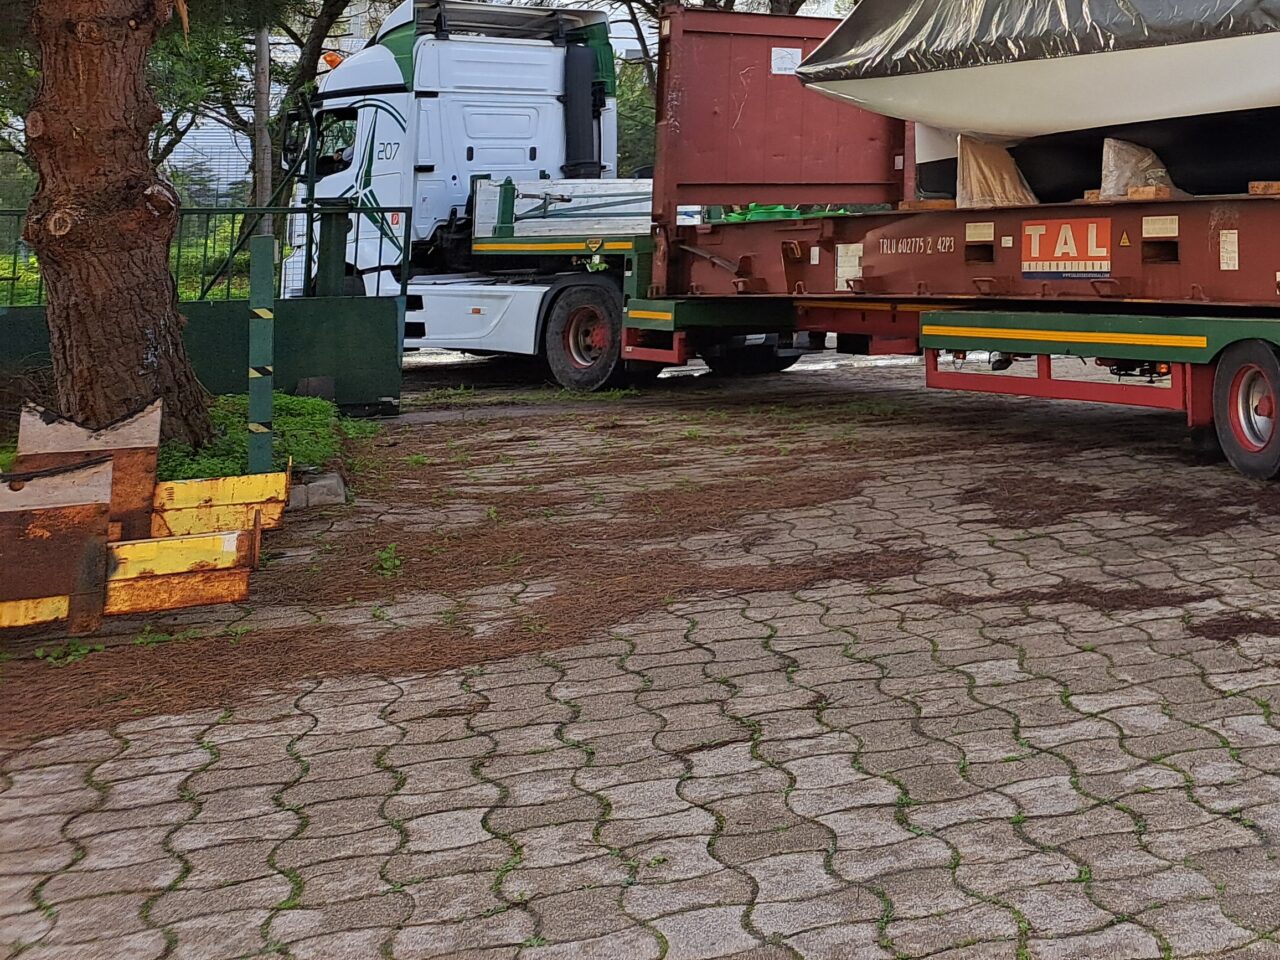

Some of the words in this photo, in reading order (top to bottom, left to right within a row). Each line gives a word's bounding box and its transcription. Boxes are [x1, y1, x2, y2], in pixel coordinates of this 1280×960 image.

[377, 142, 400, 160] 207
[879, 238, 896, 255] TRLU
[898, 237, 925, 254] 602775
[936, 236, 955, 253] 42P3
[1024, 223, 1107, 258] TAL
